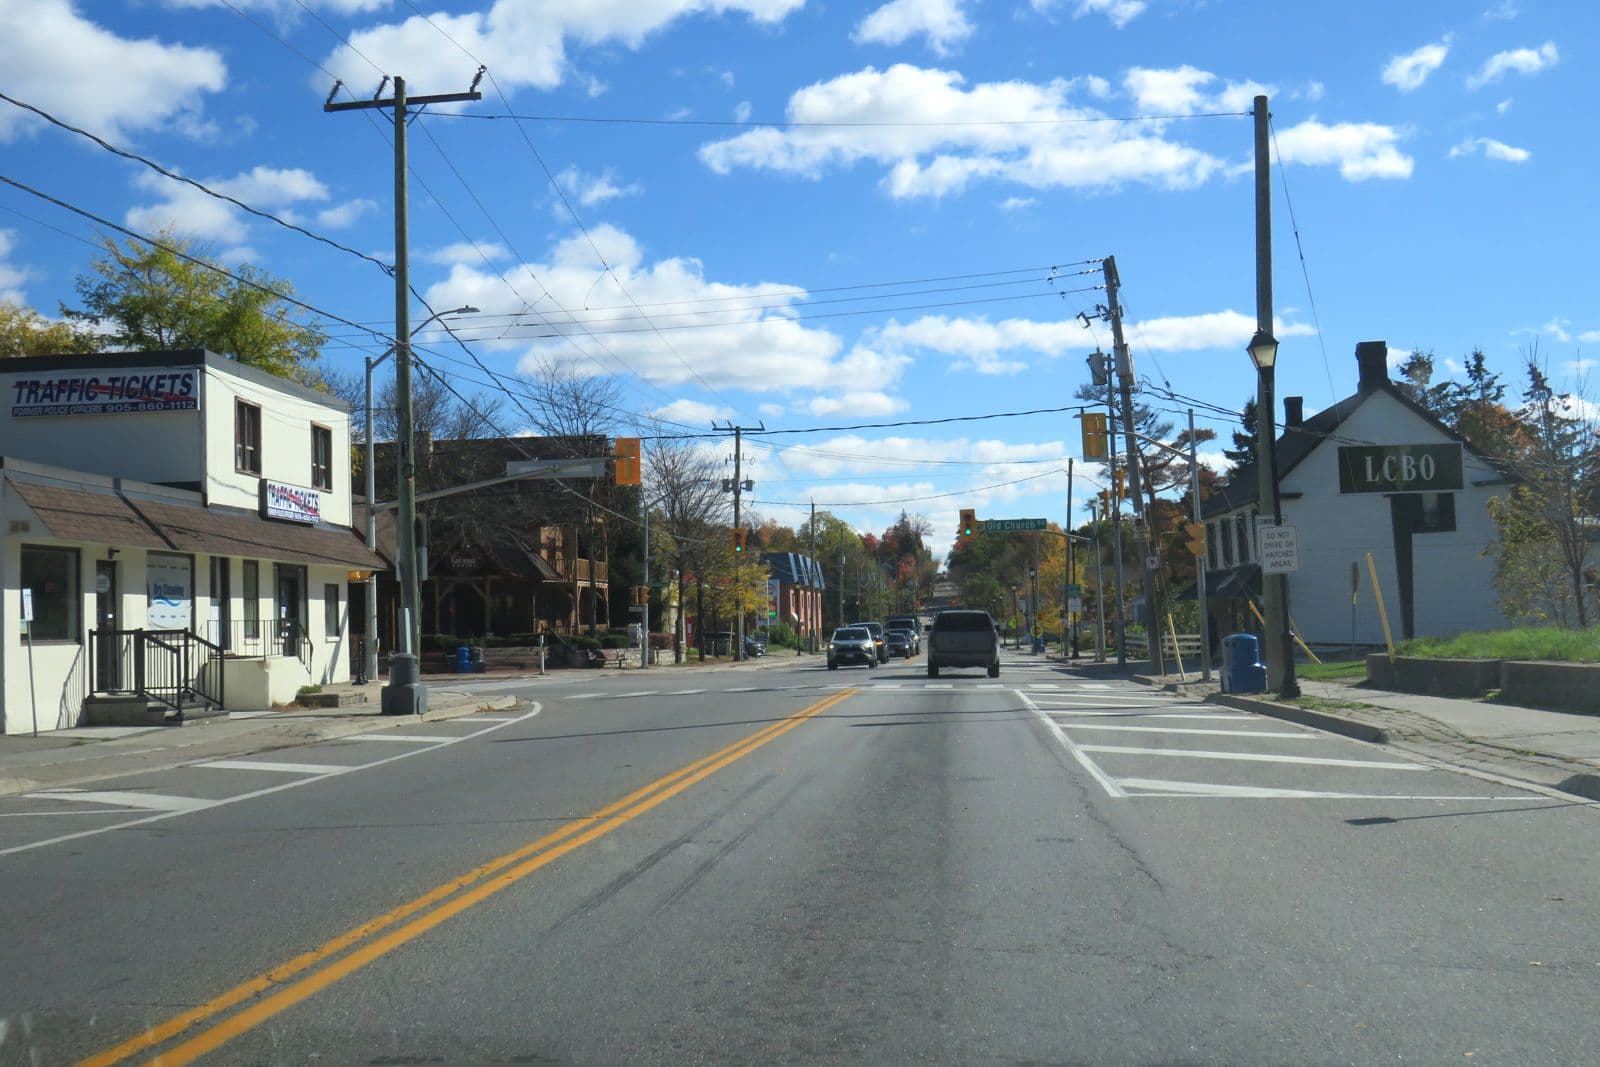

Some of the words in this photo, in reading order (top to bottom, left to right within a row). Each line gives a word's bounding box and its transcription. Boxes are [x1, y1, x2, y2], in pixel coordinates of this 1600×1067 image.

[15, 377, 101, 404] TRAFFIC
[108, 373, 194, 401] TICKETS
[106, 400, 195, 413] 905-860-1112
[1364, 454, 1436, 482] LCBO
[987, 521, 1001, 531] Old
[1005, 519, 1036, 531] Church
[1278, 530, 1289, 538] NOT
[1263, 540, 1283, 549] DRIVE
[1285, 540, 1294, 548] ON
[1263, 550, 1295, 559] HATCHED
[1271, 559, 1292, 569] AREAS
